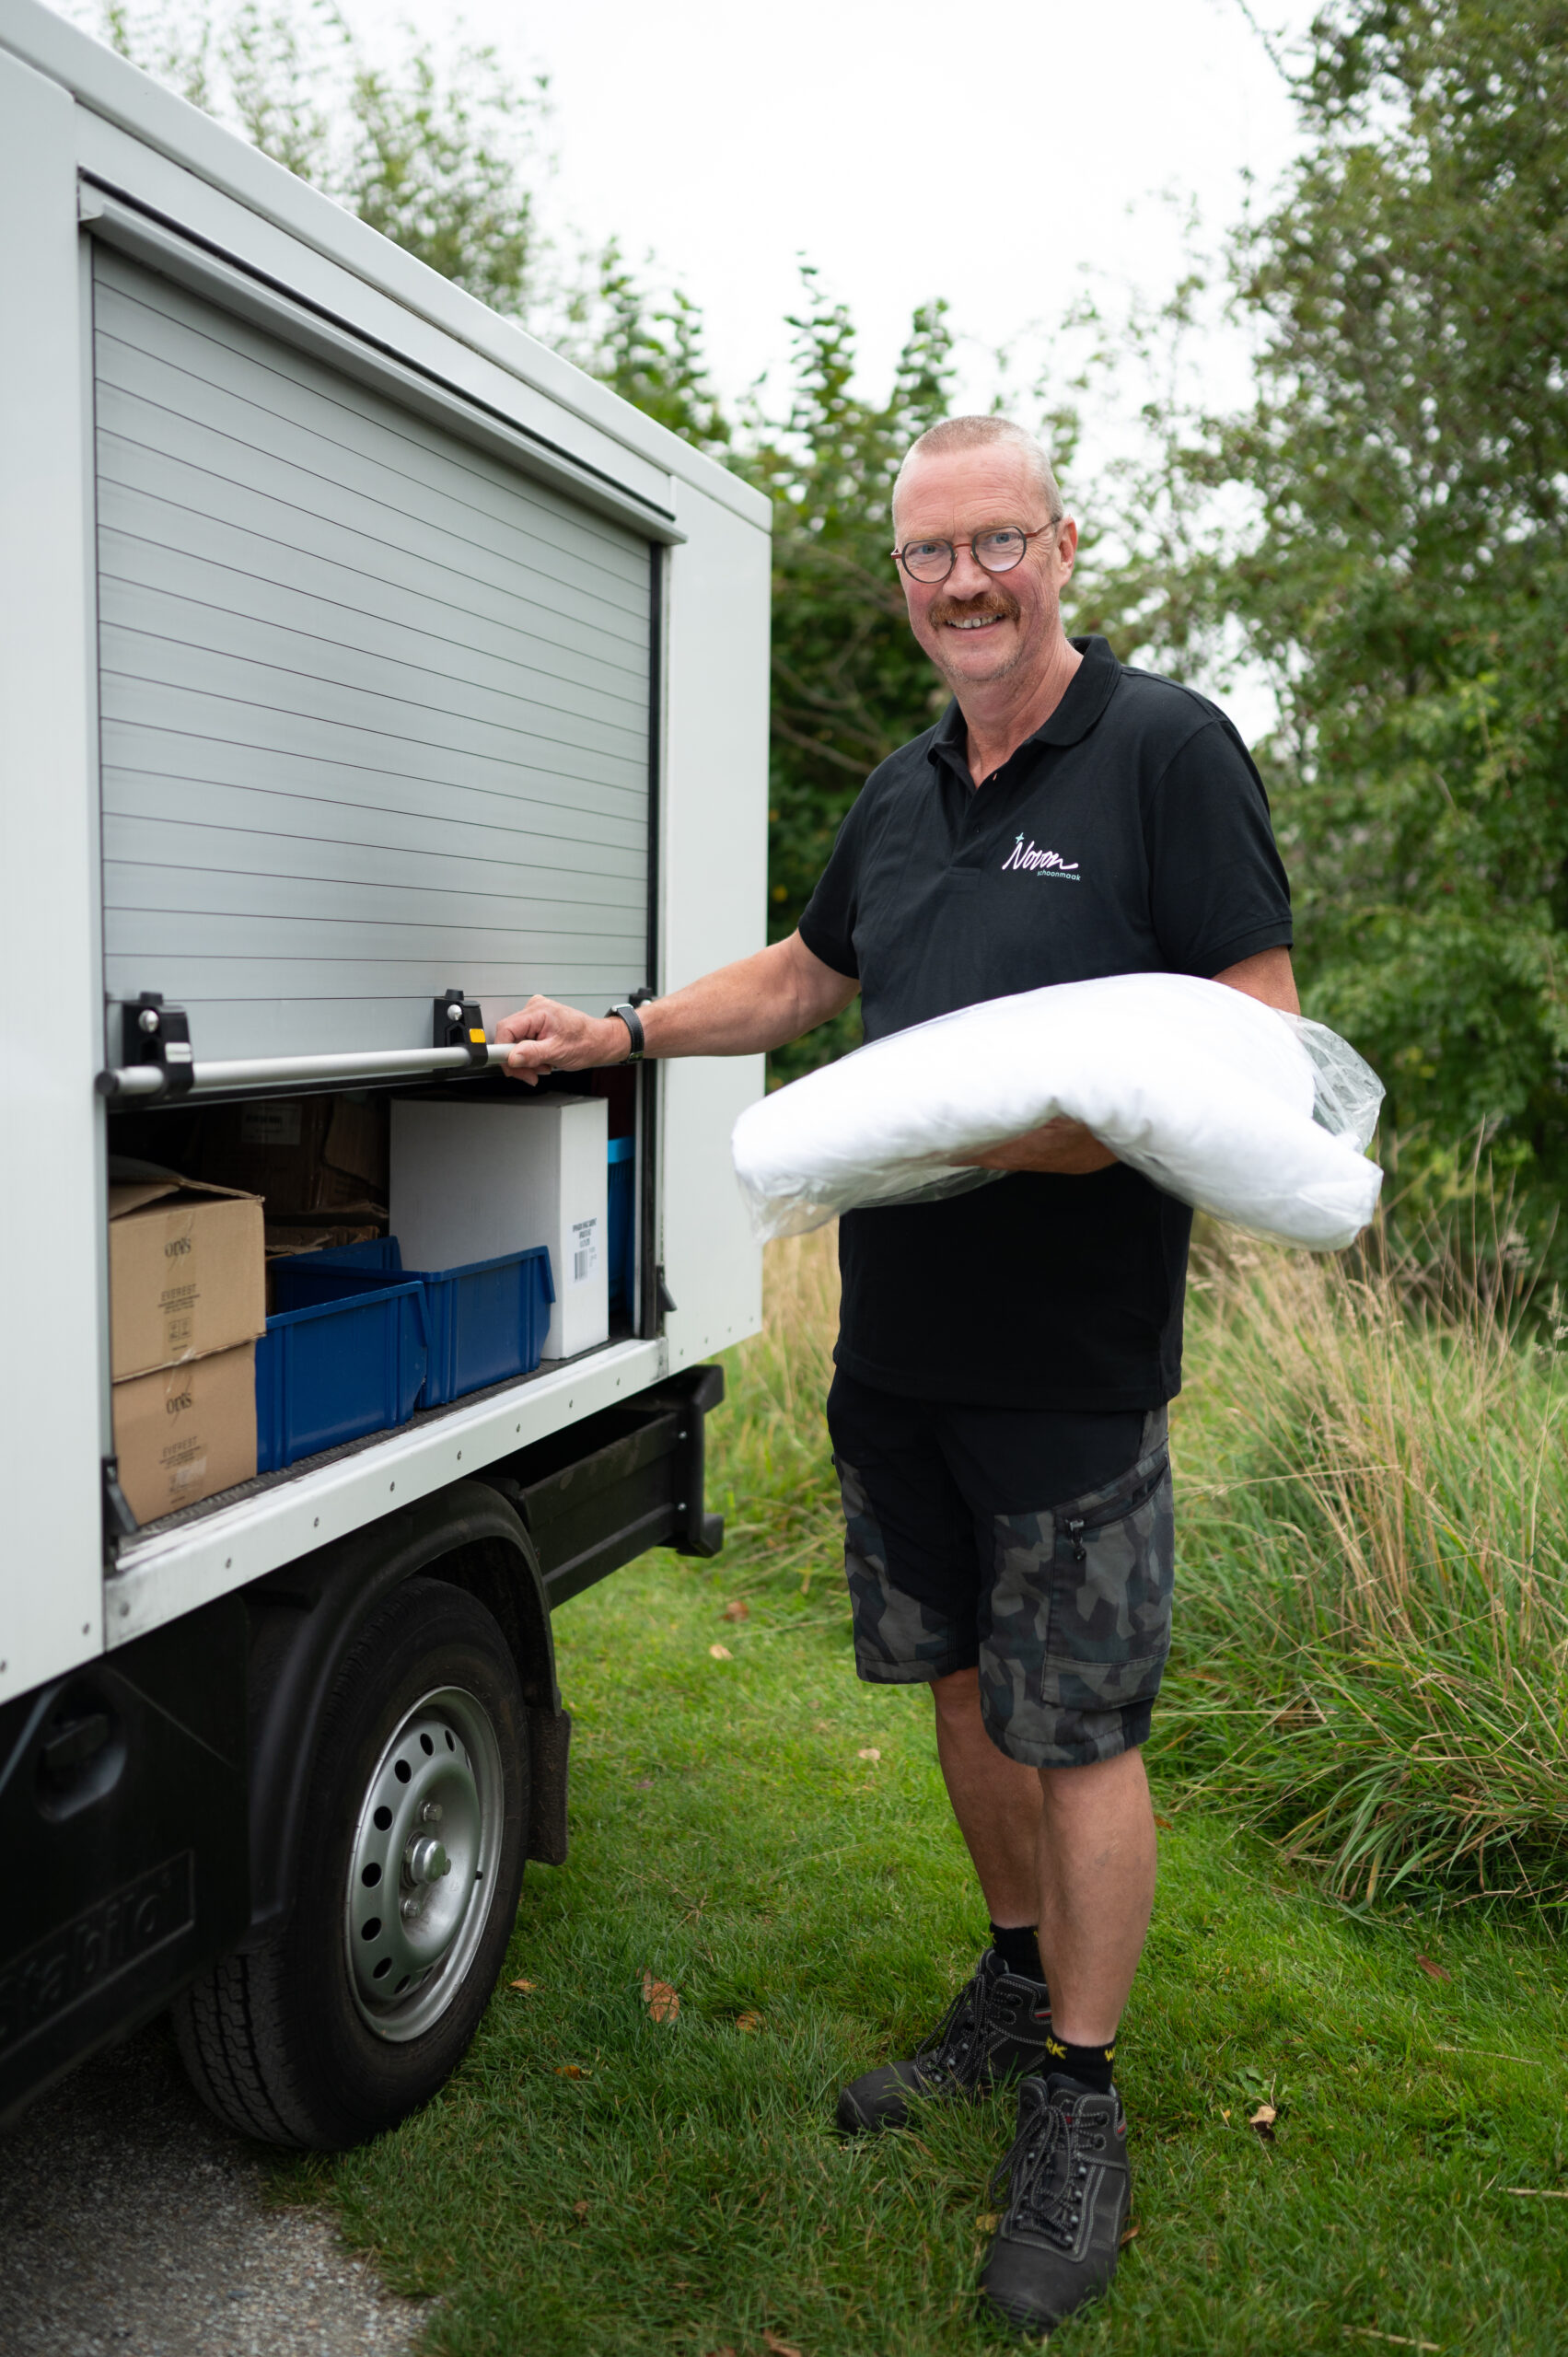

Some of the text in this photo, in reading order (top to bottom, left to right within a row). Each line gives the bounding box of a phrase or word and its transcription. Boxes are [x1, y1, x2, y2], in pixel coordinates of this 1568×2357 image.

[1002, 841, 1078, 870] Novon
[1037, 870, 1081, 881] schoonmaak
[161, 1283, 197, 1301] EVEREST
[162, 1436, 198, 1458] EVEREST
